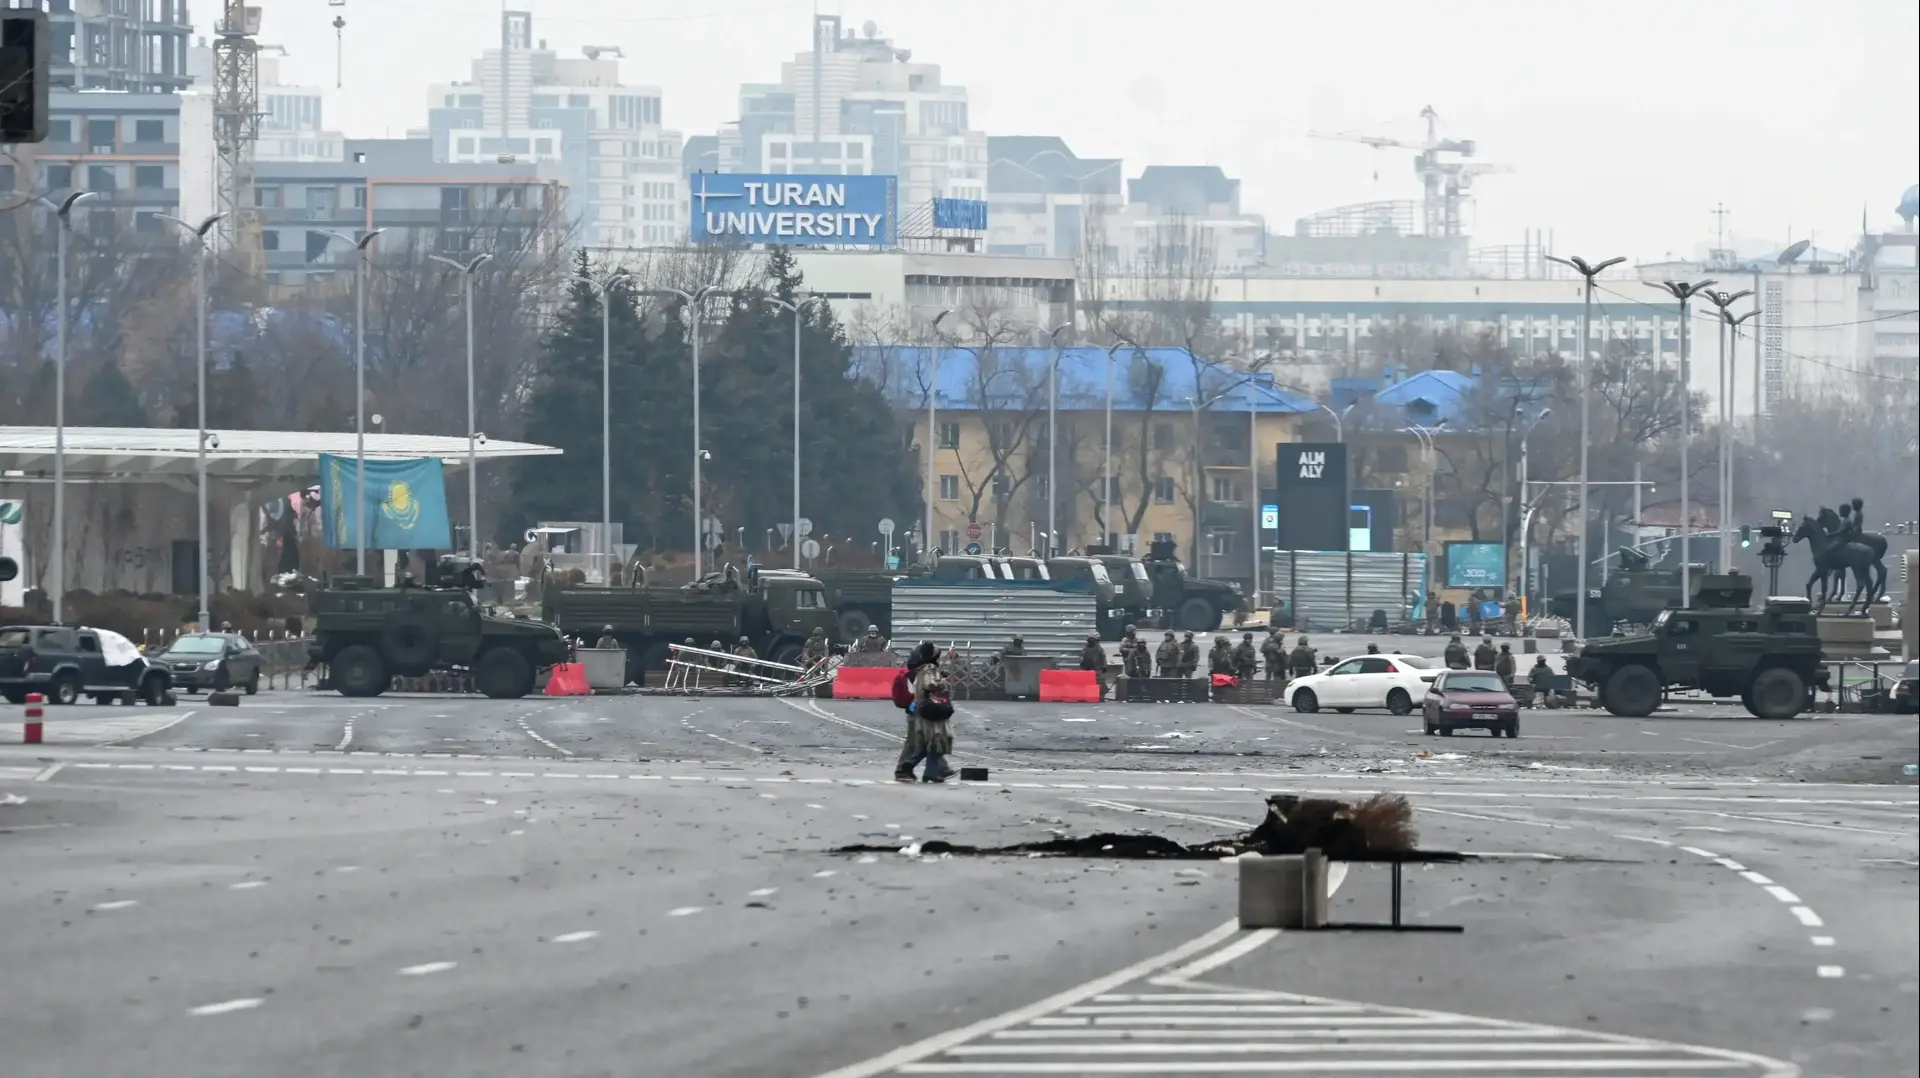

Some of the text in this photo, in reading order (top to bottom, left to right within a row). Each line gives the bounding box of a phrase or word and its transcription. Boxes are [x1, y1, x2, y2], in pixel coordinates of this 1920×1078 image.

[744, 182, 845, 207] TURAN
[706, 211, 882, 237] UNIVERSITY
[1299, 451, 1325, 465] ALM
[1300, 465, 1325, 478] ALY
